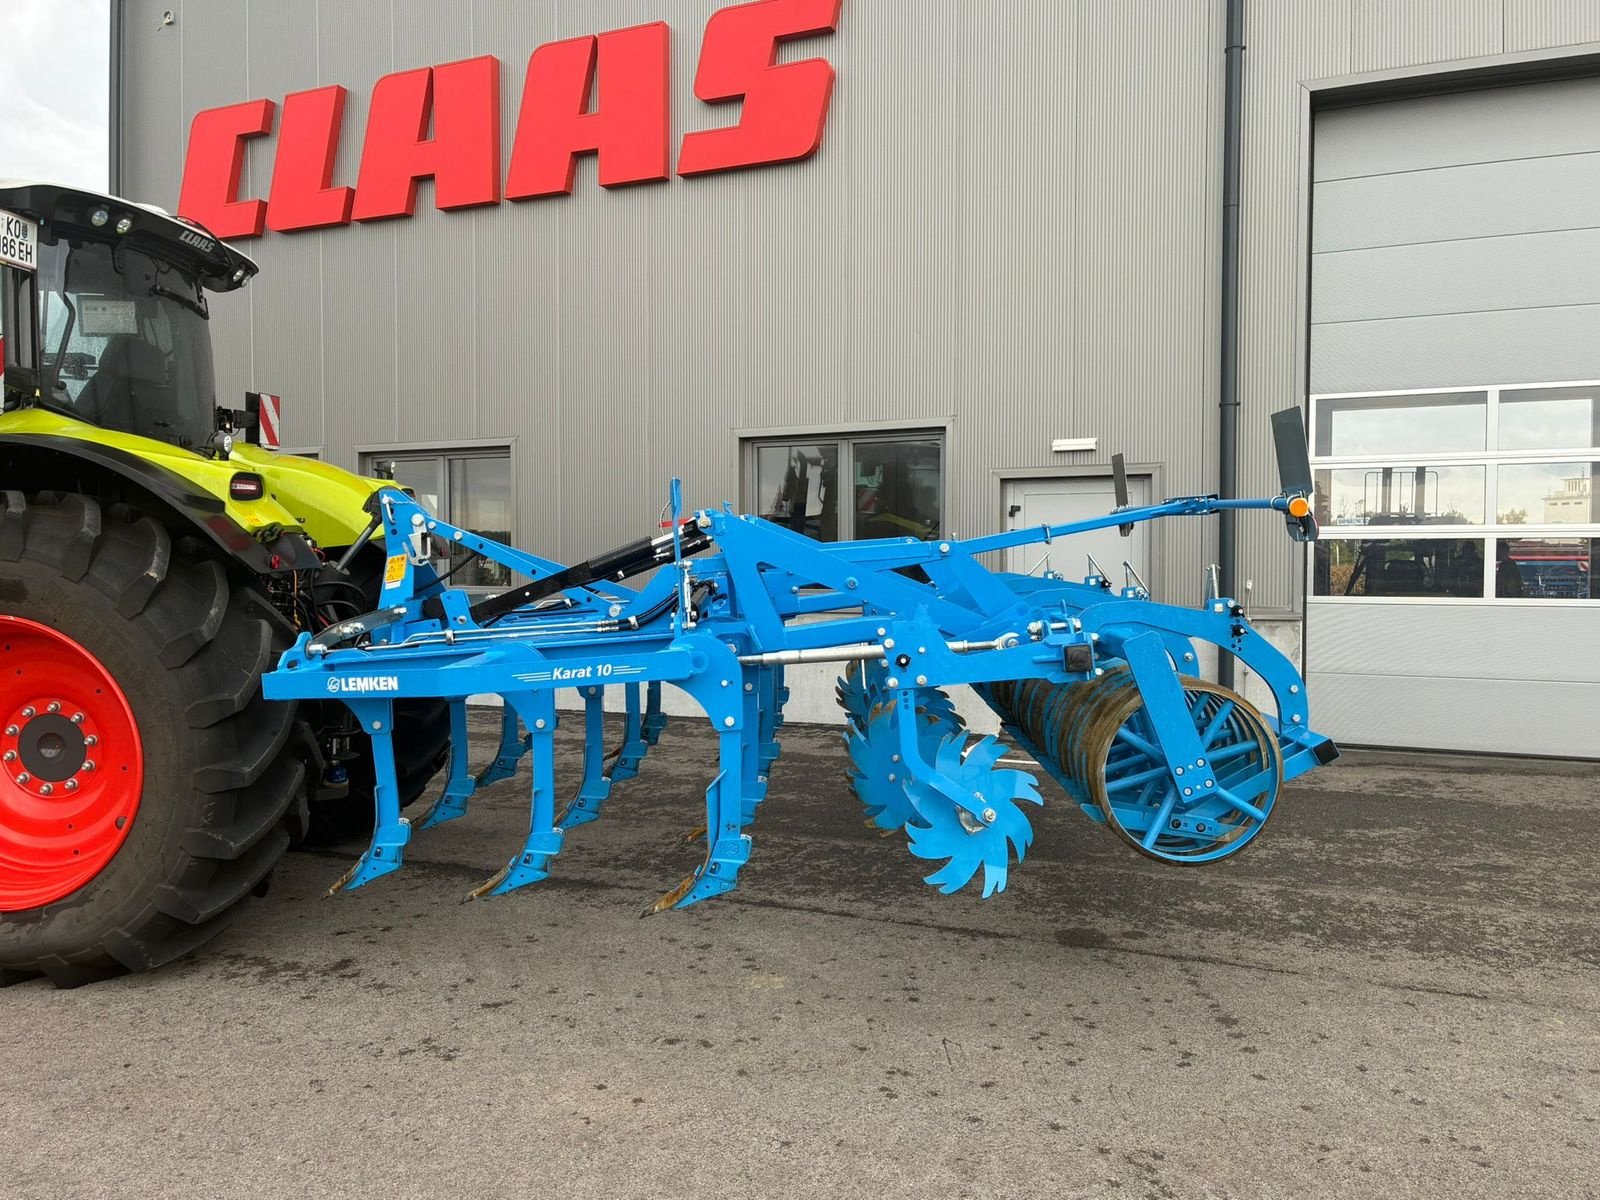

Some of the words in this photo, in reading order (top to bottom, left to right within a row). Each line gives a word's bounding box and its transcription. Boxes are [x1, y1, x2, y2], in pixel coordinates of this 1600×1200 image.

[179, 0, 841, 238] CLAAS
[6, 216, 21, 239] KO
[0, 234, 16, 258] 86
[18, 241, 33, 264] EH
[179, 230, 215, 253] CLAAS
[552, 665, 593, 681] Karat
[596, 663, 613, 677] 10
[340, 676, 399, 694] LEMKEN
